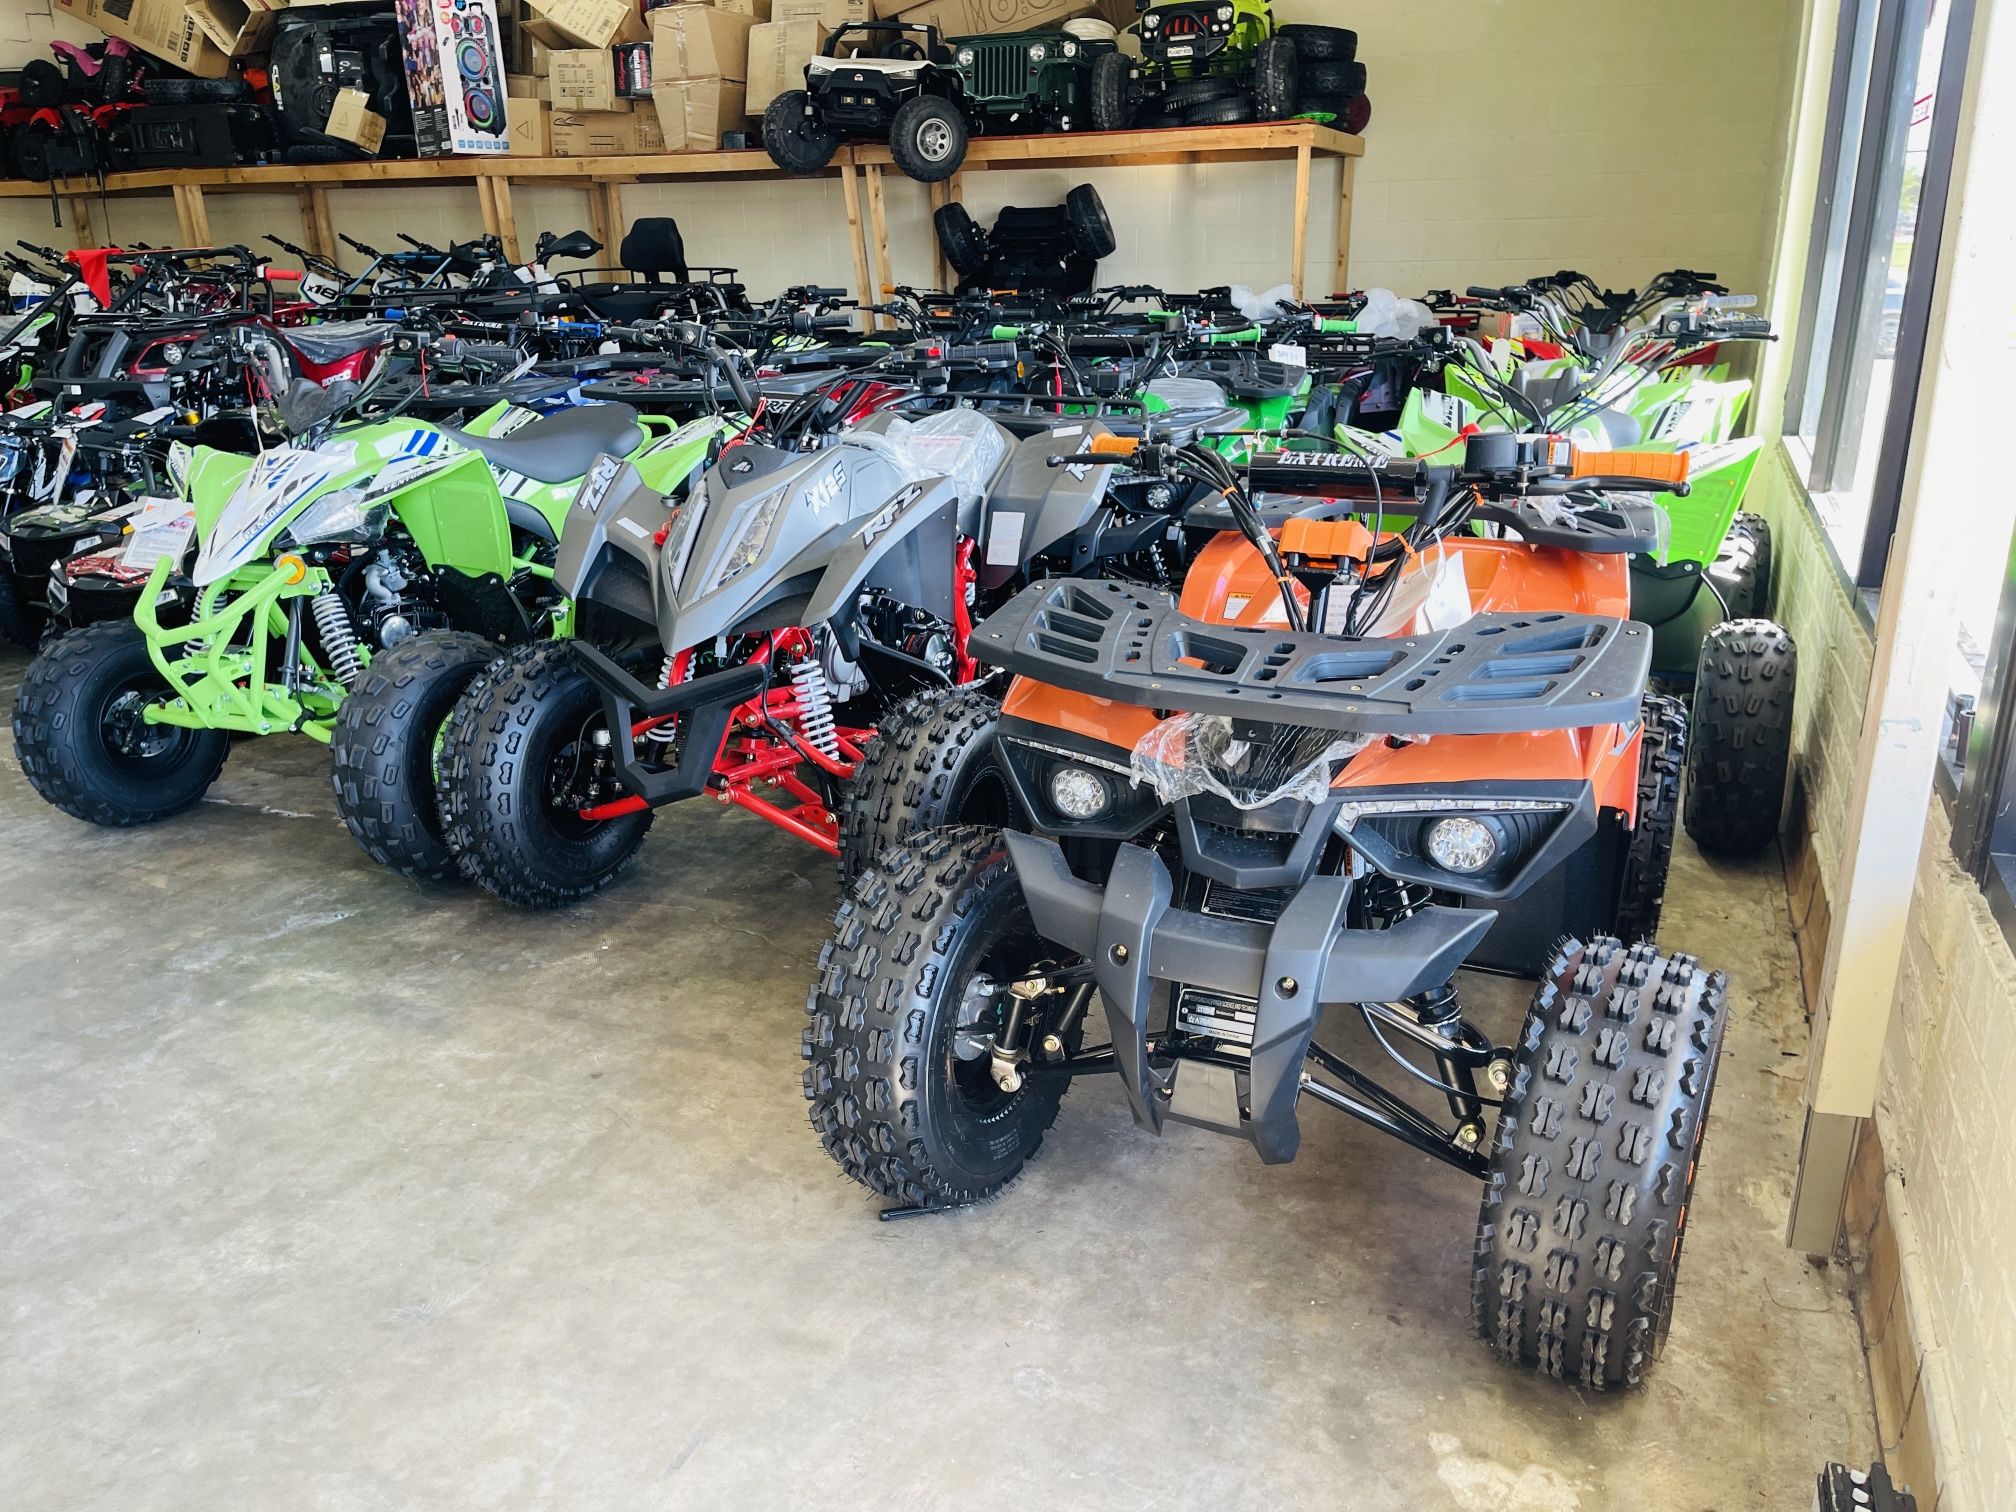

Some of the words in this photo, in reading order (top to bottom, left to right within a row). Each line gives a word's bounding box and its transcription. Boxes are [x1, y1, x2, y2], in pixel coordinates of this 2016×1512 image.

[271, 64, 285, 111] CLASH
[1277, 451, 1389, 469] EXTREME
[852, 483, 923, 551] RFZ
